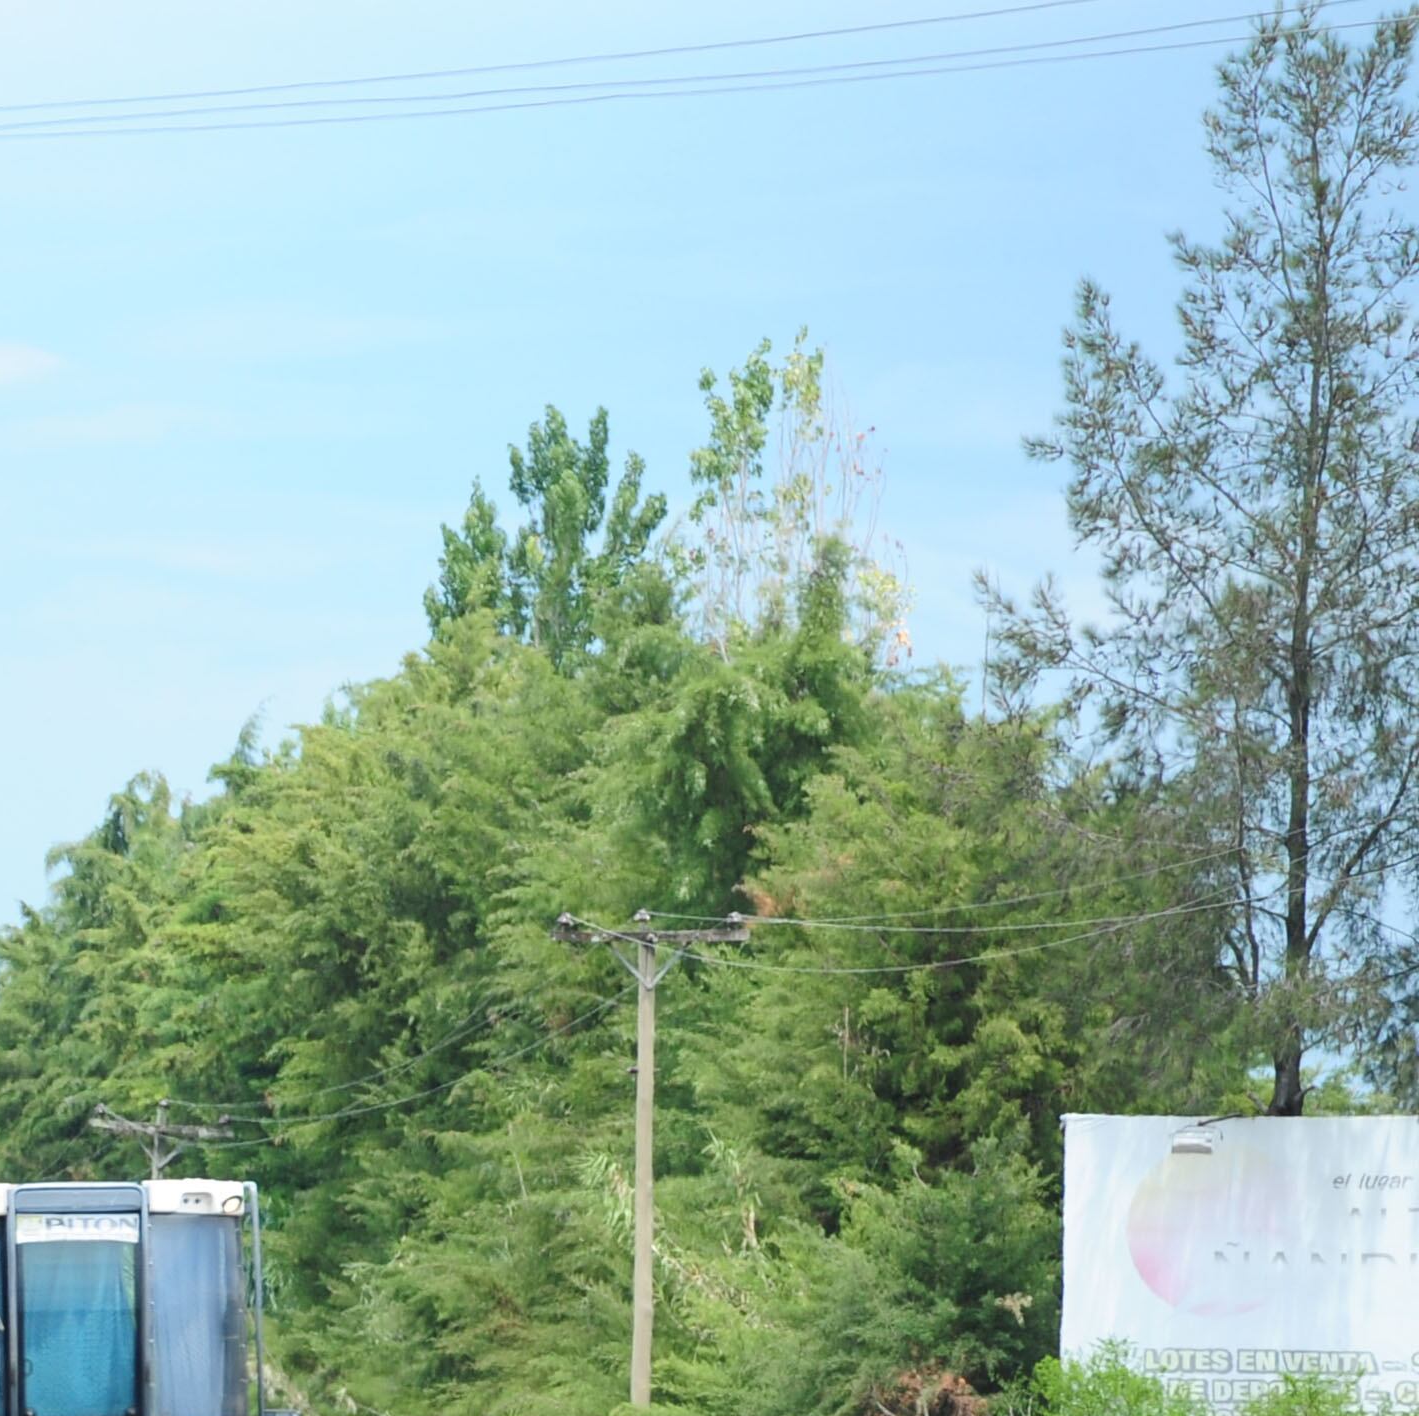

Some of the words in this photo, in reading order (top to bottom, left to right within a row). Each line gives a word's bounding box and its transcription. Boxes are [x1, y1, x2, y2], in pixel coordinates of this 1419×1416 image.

[1143, 1348, 1232, 1373] LOTES
[1237, 1349, 1280, 1373] EN
[1281, 1351, 1378, 1374] VENTA
